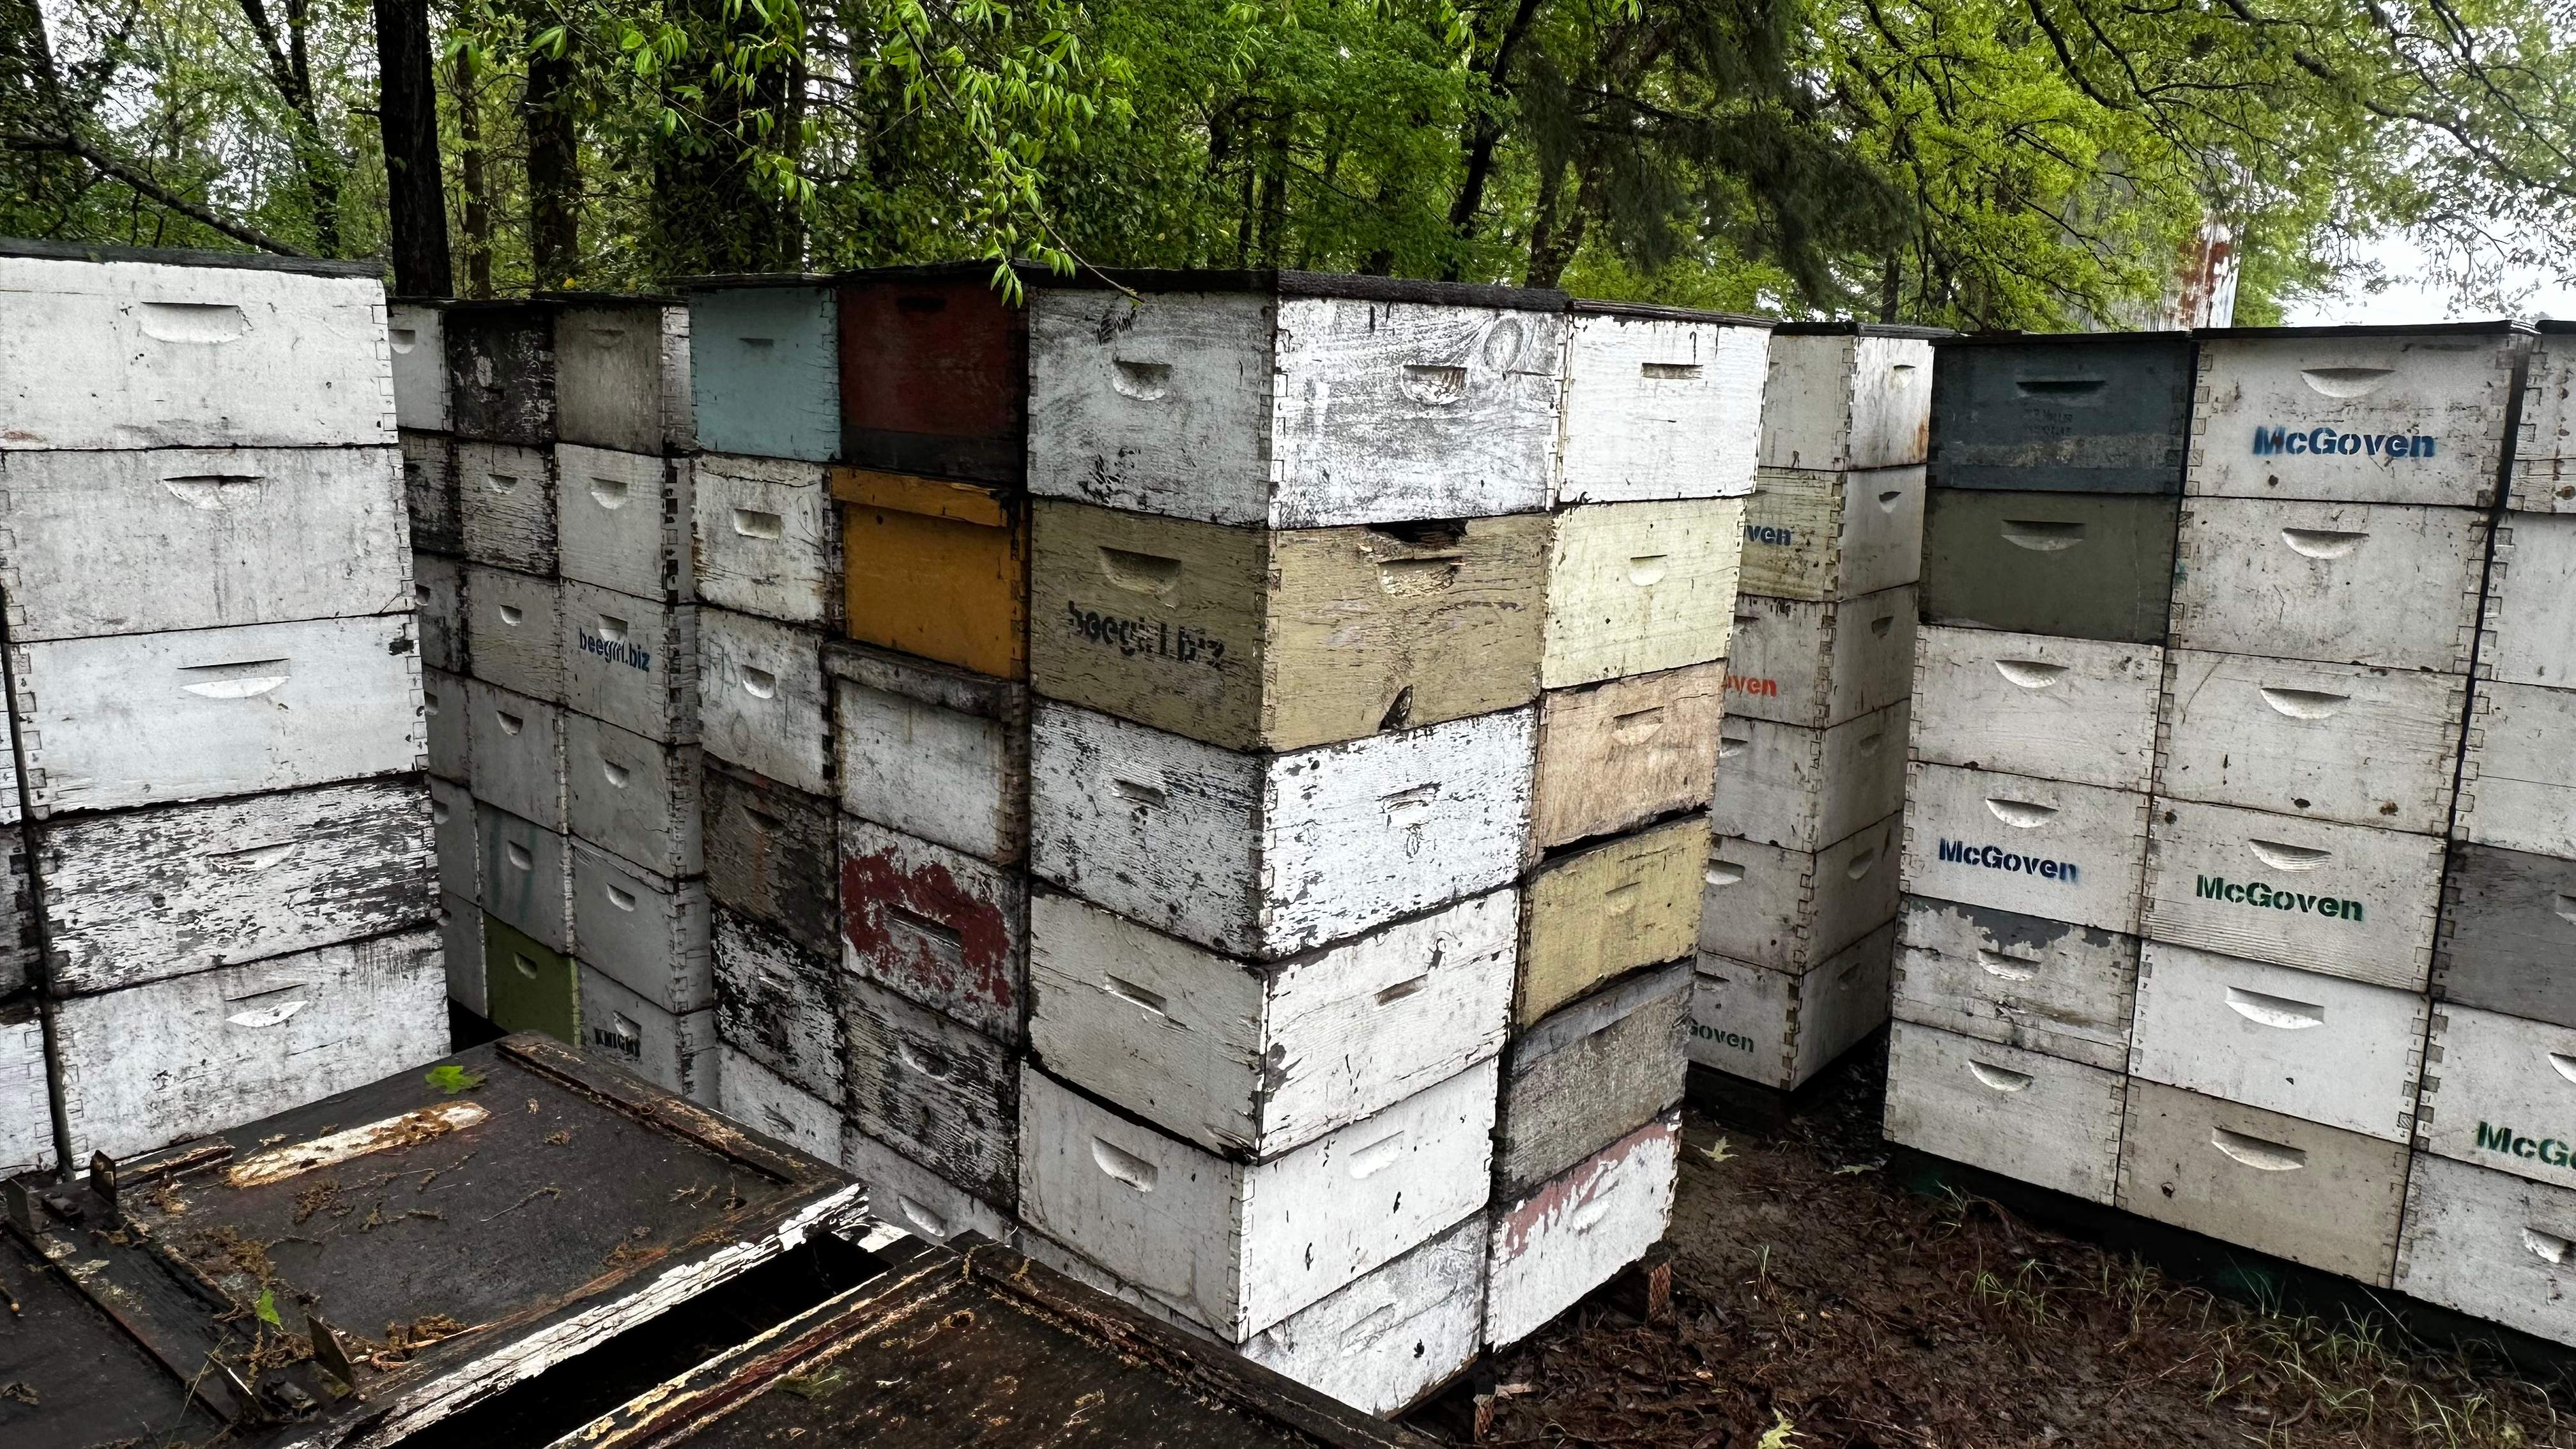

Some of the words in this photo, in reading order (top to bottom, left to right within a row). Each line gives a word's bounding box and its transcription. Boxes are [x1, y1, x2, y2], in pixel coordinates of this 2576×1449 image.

[2253, 425, 2437, 458] McGoven
[1744, 525, 1791, 546] ven
[1939, 838, 2080, 881] McGoven
[2196, 874, 2363, 921] McGoven
[2477, 1121, 2576, 1169] McG
